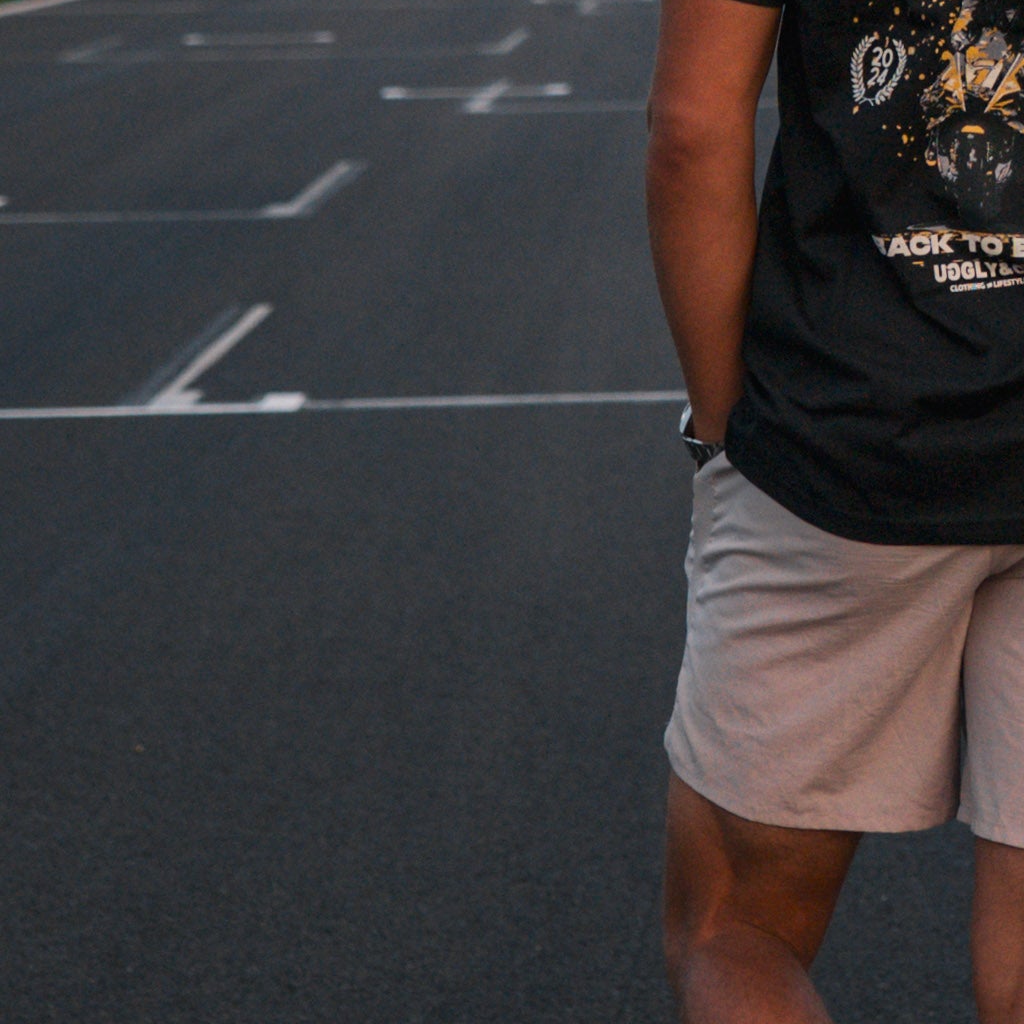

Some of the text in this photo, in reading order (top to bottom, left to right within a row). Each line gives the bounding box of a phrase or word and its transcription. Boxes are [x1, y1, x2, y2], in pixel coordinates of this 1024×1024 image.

[871, 46, 894, 68] 20
[866, 66, 889, 87] 24
[963, 234, 1004, 256] TO
